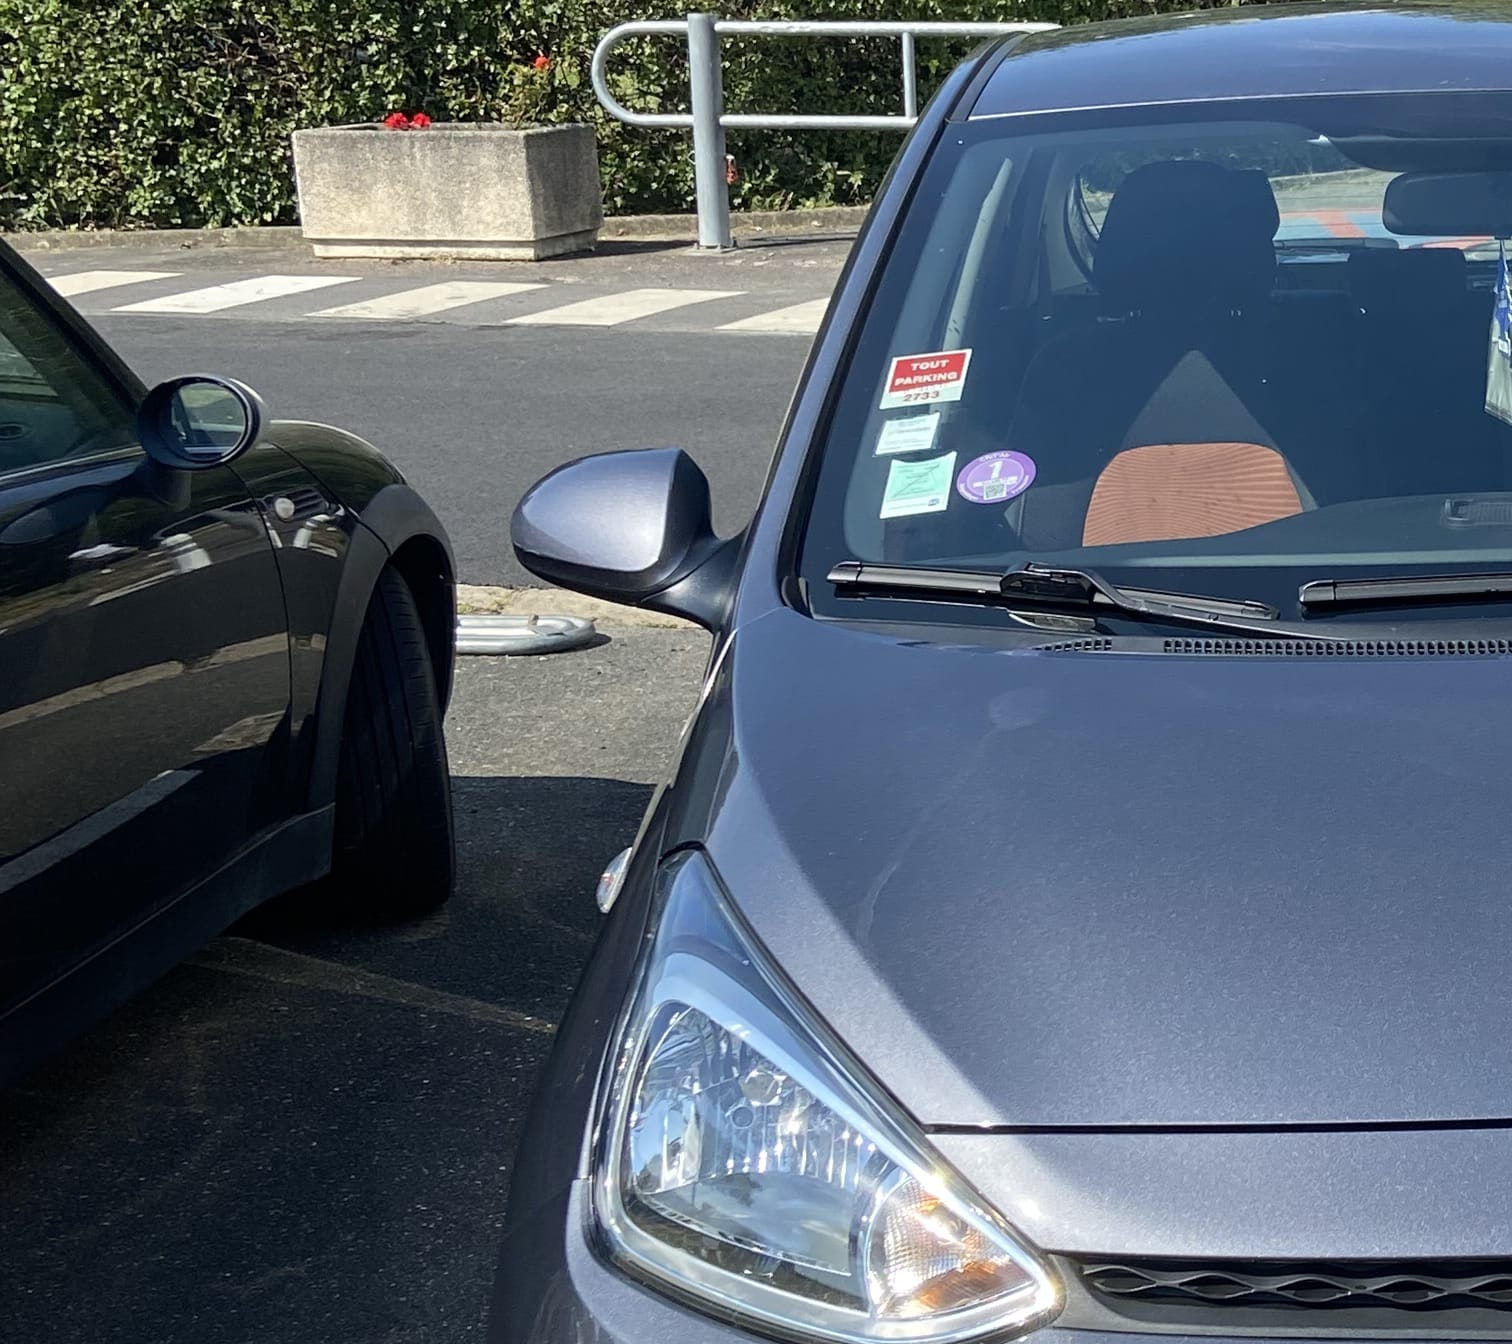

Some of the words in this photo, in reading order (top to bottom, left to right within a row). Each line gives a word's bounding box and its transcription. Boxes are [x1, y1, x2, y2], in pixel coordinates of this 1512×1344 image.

[911, 359, 950, 371] TOUT
[894, 371, 958, 386] PARKING
[903, 390, 940, 402] 2733
